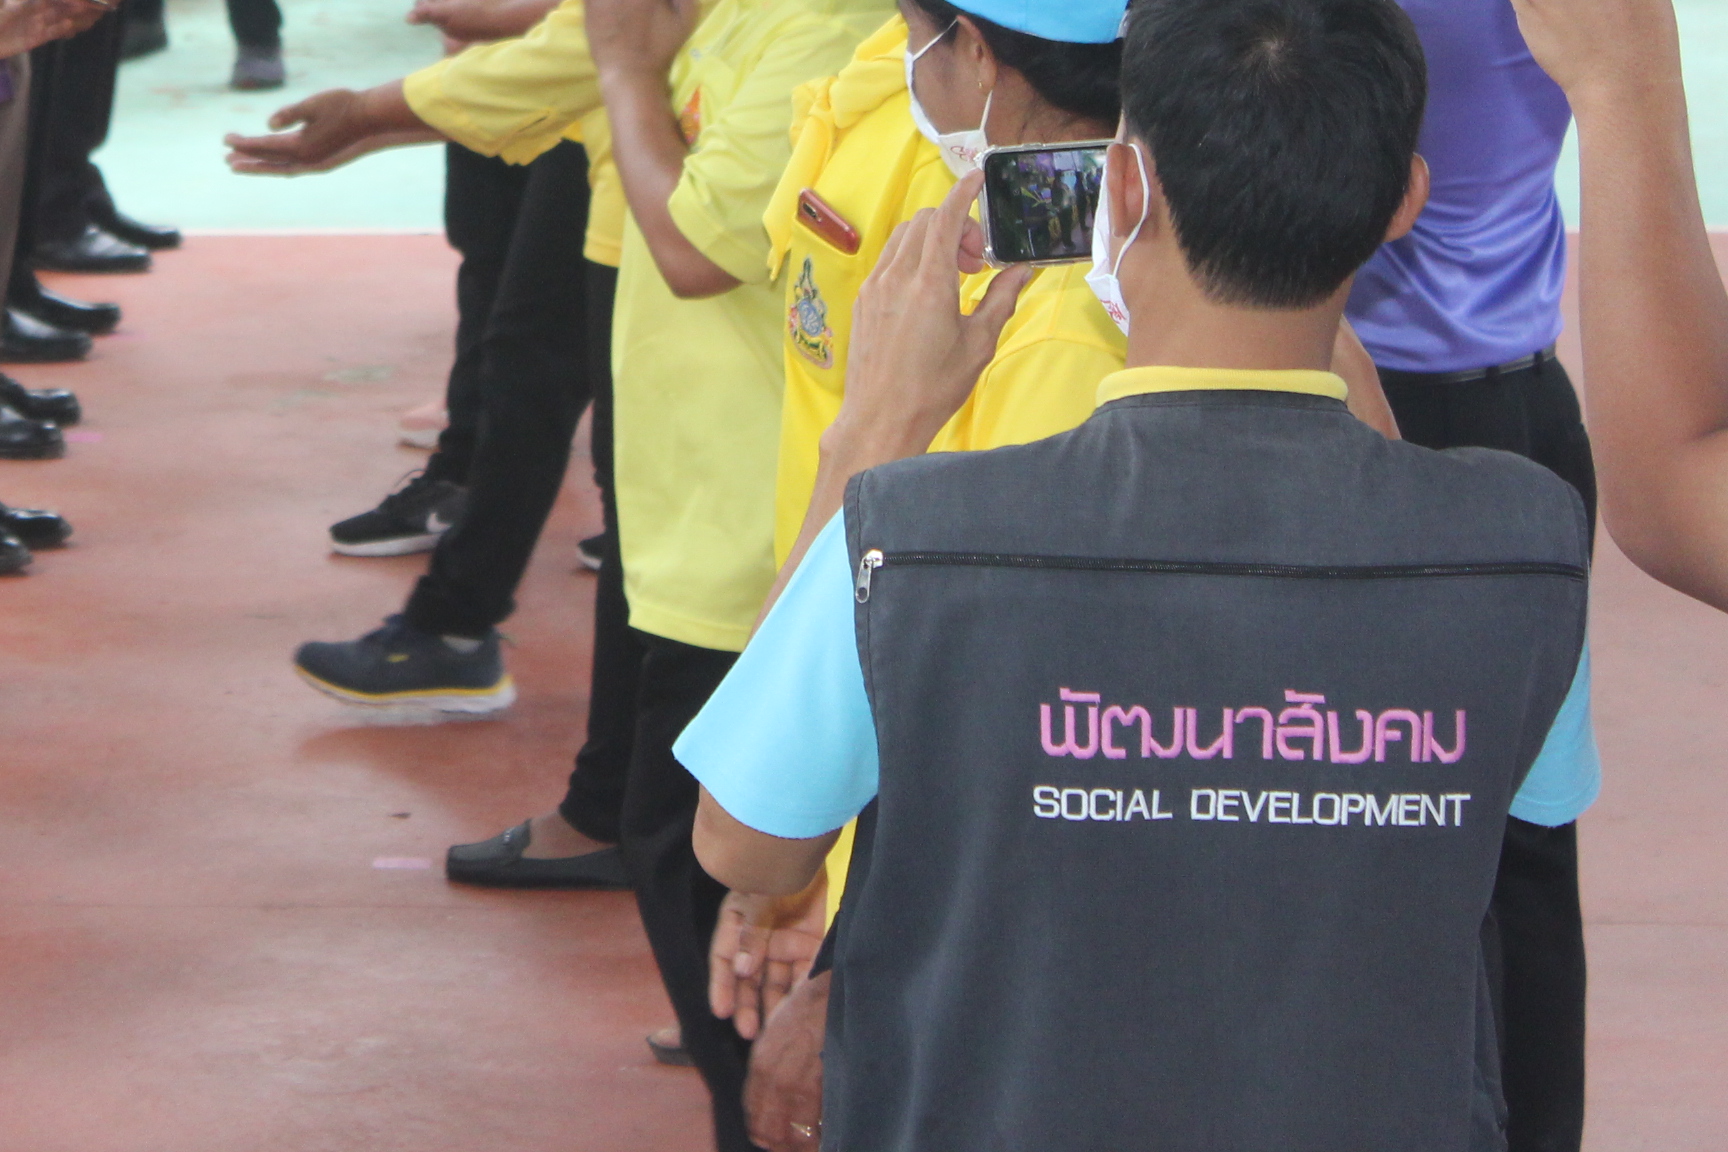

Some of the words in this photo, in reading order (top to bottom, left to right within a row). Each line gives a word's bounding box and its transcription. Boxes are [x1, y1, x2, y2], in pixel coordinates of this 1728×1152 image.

[1040, 687, 1466, 764] พัฒนาสังคม
[1033, 785, 1173, 822] SOCIAL
[1190, 788, 1471, 826] DEVELOPMENT
